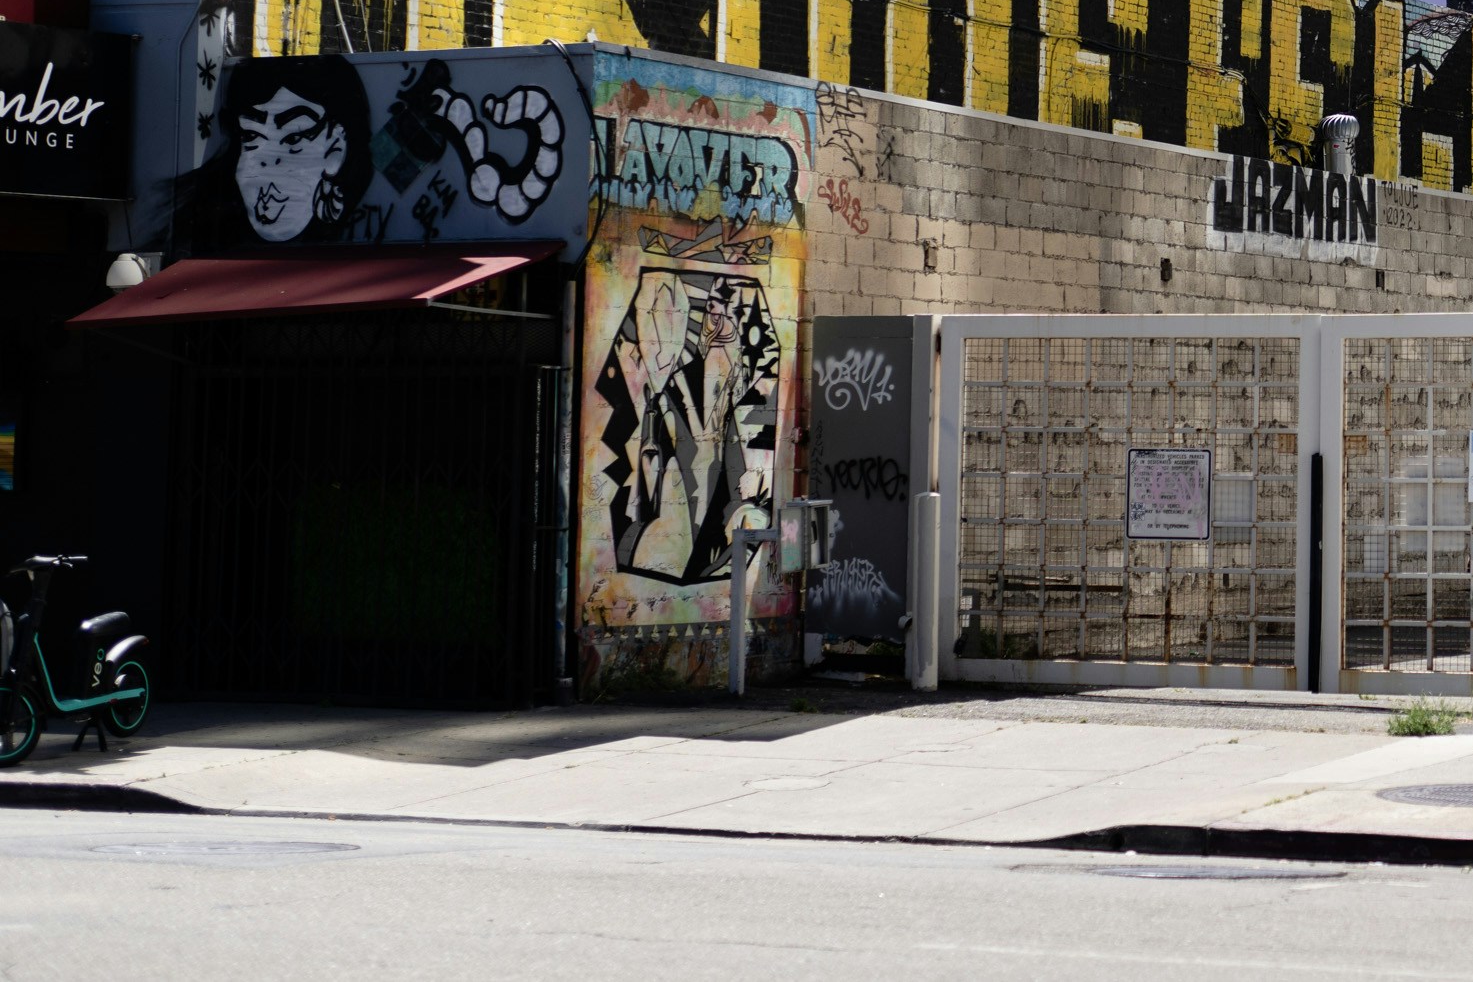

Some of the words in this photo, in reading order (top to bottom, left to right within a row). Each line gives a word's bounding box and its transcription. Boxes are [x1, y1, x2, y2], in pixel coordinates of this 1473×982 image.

[5, 128, 74, 149] UNGE
[1213, 154, 1377, 244] JAZMAN
[91, 648, 105, 687] veo
